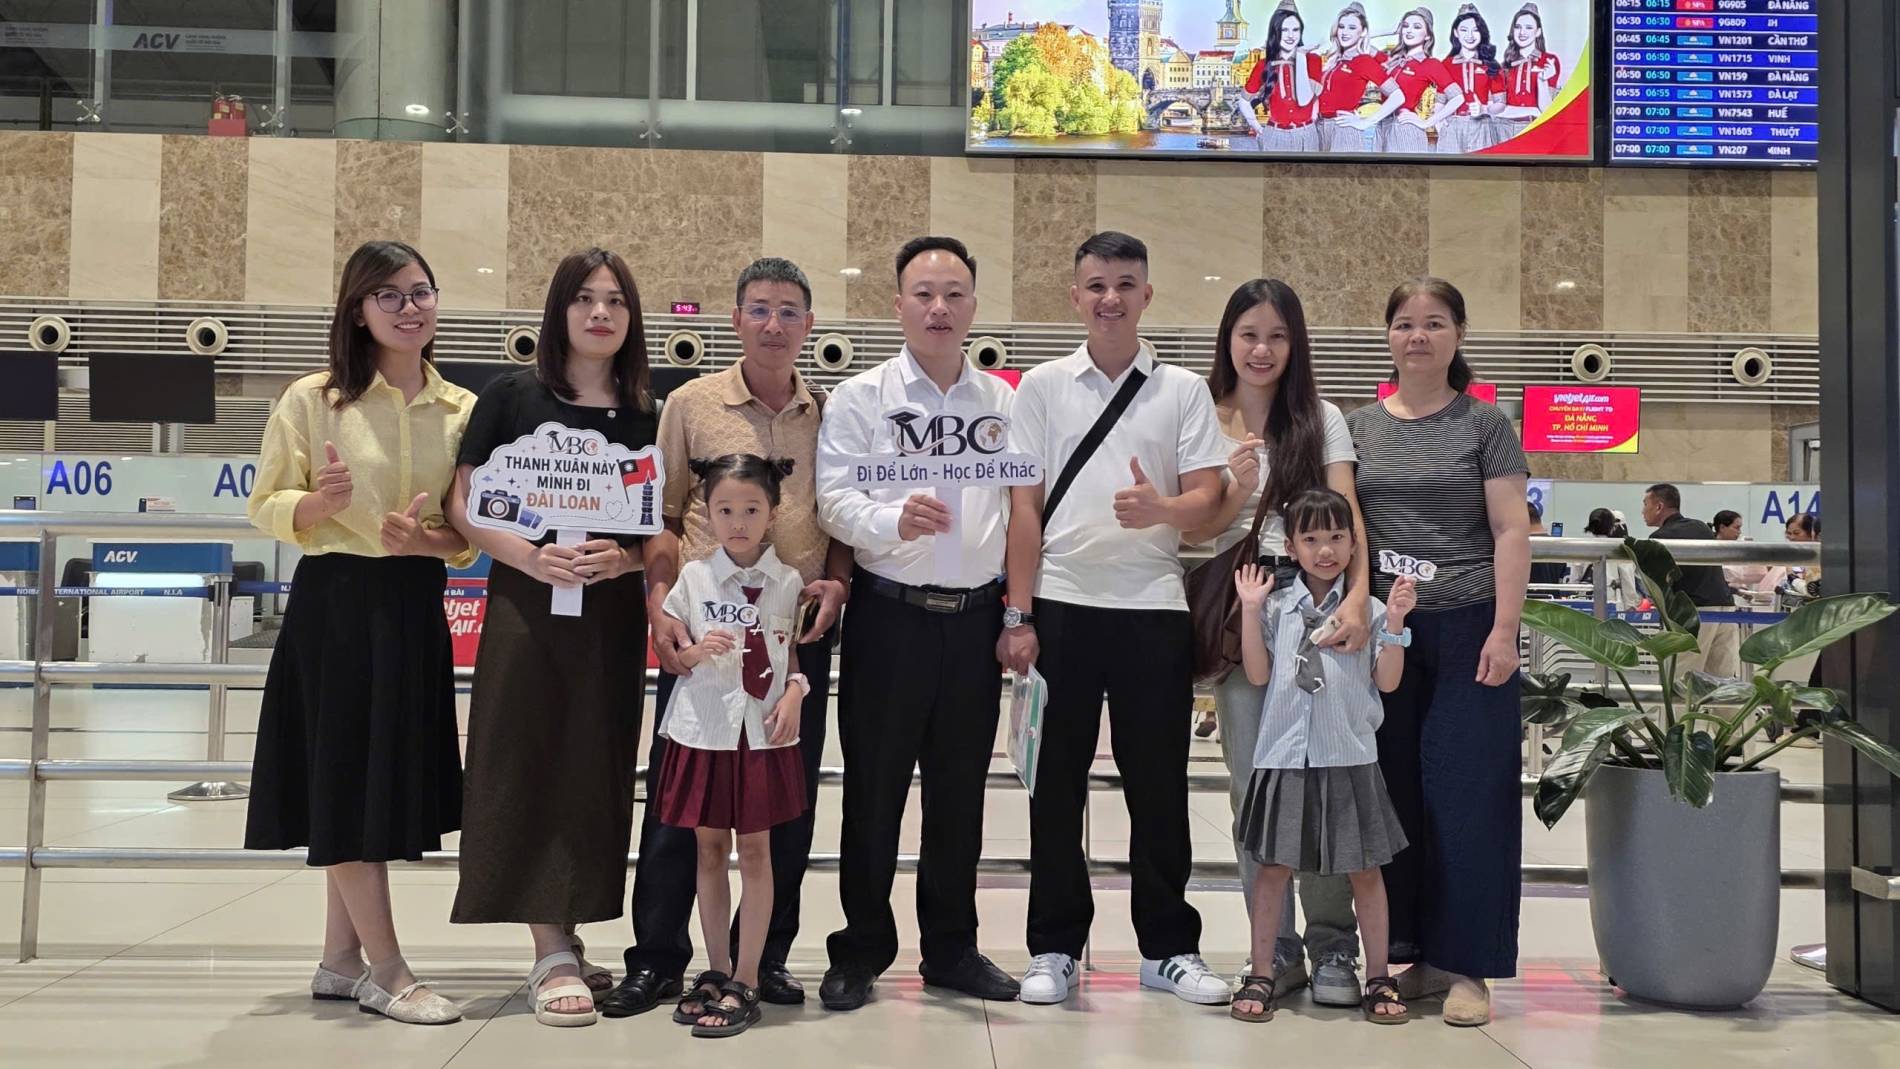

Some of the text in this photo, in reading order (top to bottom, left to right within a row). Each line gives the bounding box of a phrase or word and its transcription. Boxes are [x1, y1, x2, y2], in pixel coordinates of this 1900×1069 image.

[1616, 16, 1641, 25] 06:30
[1645, 17, 1670, 25] 06:30
[1718, 18, 1746, 27] 9G809
[133, 33, 180, 49] ACV
[1616, 34, 1641, 43] 06:45
[1645, 35, 1670, 43] 06:45
[1718, 36, 1752, 45] VN1201
[1616, 52, 1791, 63] 06:50 06:50 VN1715 VINH
[1616, 71, 1641, 79] 06:50
[1645, 71, 1670, 79] 06:50
[1718, 72, 1748, 81] VN159
[1767, 71, 1781, 82] ĐÀ
[1616, 88, 1641, 97] 06:55
[1645, 89, 1670, 97] 06:55
[1718, 90, 1752, 99] VN1573
[1616, 106, 1788, 118] 07:00 07:00 VN7543 HUẾ
[1616, 126, 1800, 138] 07:00 07:00 VN1603 THUỘT
[1616, 144, 1641, 153] 07:00
[1645, 145, 1670, 153] 07:00
[1718, 146, 1747, 155] VN207
[547, 431, 599, 456] MBC
[891, 412, 1006, 457] MBC
[505, 456, 616, 476] THANH XUÂN NÀY
[857, 465, 871, 482] Đi
[877, 461, 896, 482] Để
[901, 464, 927, 481] Lớn
[943, 463, 971, 483] Học
[976, 459, 995, 479] Để
[1000, 461, 1035, 478] Khác
[46, 460, 112, 495] A06
[213, 463, 256, 498] A0
[537, 473, 590, 491] MÌNH ĐI
[526, 490, 600, 510] ĐÀI LOAN
[104, 550, 137, 563] ACV
[1384, 552, 1434, 578] MBC
[444, 599, 480, 620] tjet
[703, 601, 756, 624] MBC
